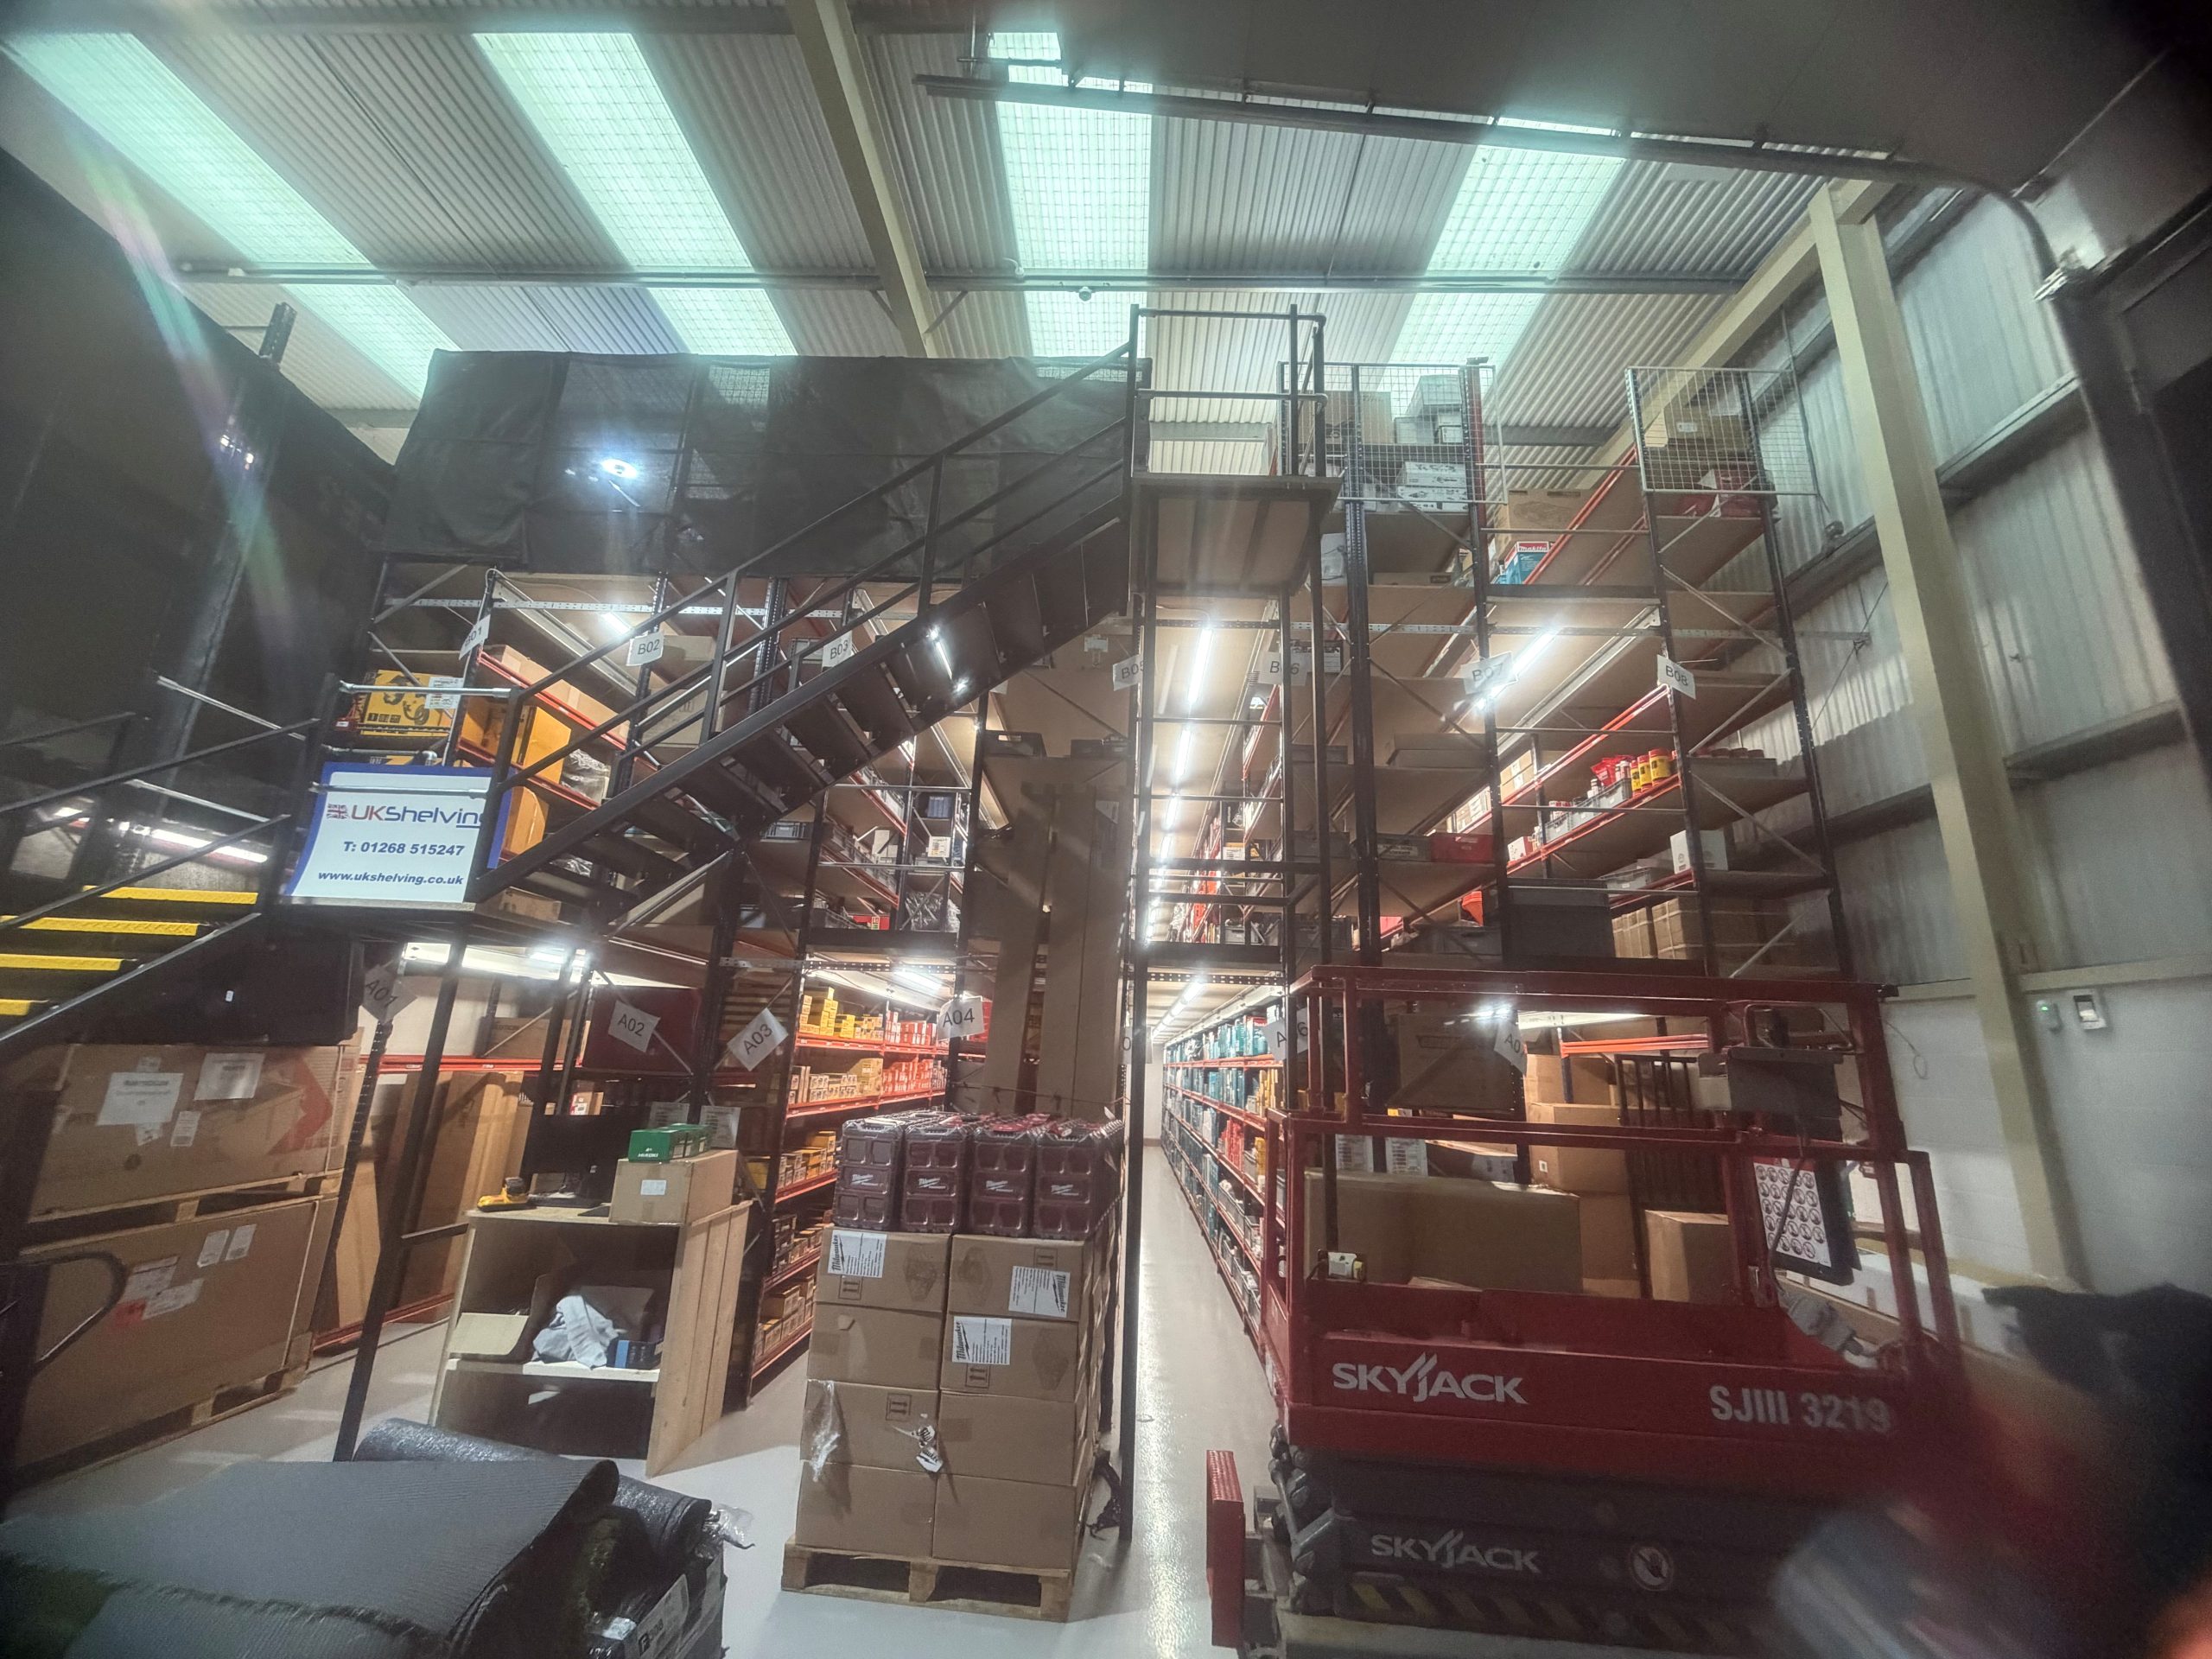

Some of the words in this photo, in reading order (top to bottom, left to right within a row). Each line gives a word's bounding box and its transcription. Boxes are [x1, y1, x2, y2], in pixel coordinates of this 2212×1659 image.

[638, 639, 660, 655] B02
[830, 639, 849, 659] B03
[1270, 661, 1300, 675] B6
[1472, 663, 1503, 682] B07
[1666, 664, 1688, 686] B08
[351, 804, 481, 825] UKShelvin
[343, 841, 356, 853] T:
[360, 842, 405, 854] 01268
[410, 843, 465, 855] 515247
[318, 871, 464, 886] www.ukshelving.co.uk
[366, 979, 398, 1009] A01
[618, 1014, 645, 1037] A02
[943, 1007, 975, 1028] A04
[743, 1023, 772, 1055] A03
[1276, 1021, 1308, 1048] A6
[1503, 1033, 1522, 1054] A0
[1332, 1351, 1529, 1405] SKYJACK
[1709, 1385, 1790, 1425] SJIII
[1800, 1392, 1892, 1434] 3219
[1370, 1529, 1542, 1574] SKYJACK
